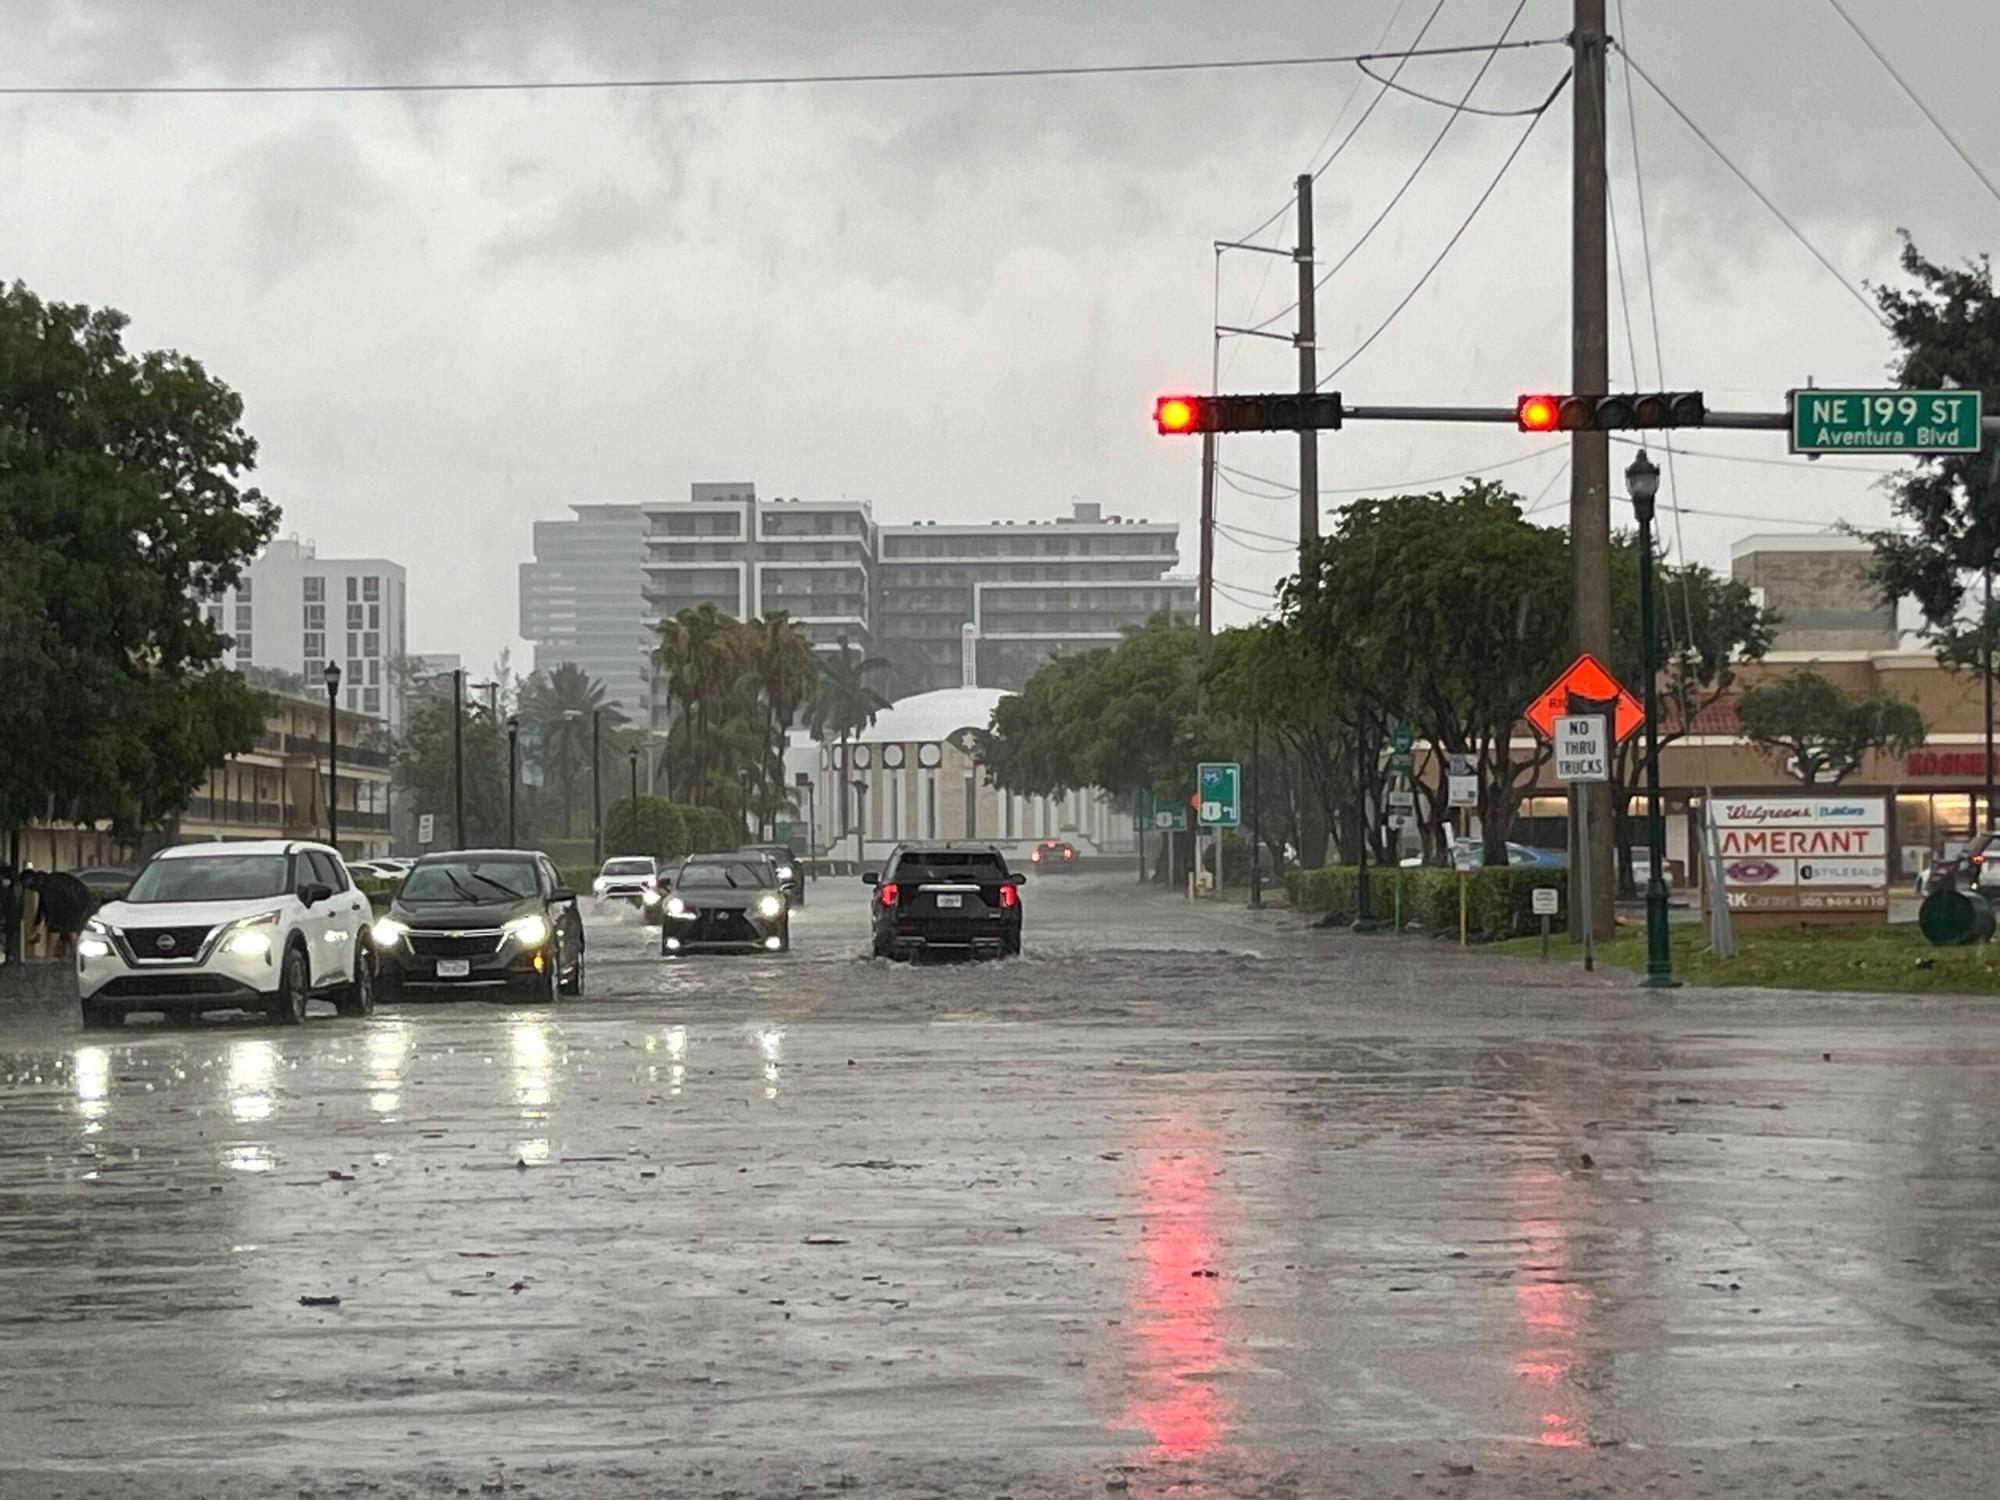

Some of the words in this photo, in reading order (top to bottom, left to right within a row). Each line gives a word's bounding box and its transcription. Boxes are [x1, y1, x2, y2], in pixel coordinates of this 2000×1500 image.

[1812, 399, 1848, 424] NE
[1861, 397, 1918, 426] 199
[1931, 399, 1962, 424] ST
[1816, 426, 1904, 446] Aventura
[1916, 426, 1960, 446] Blvd
[1569, 721, 1589, 736] NO
[1564, 741, 1596, 755] THRU
[1558, 760, 1603, 775] TRUCKS
[1725, 804, 1812, 824] Walgreens
[1722, 831, 1869, 853] AMERANT
